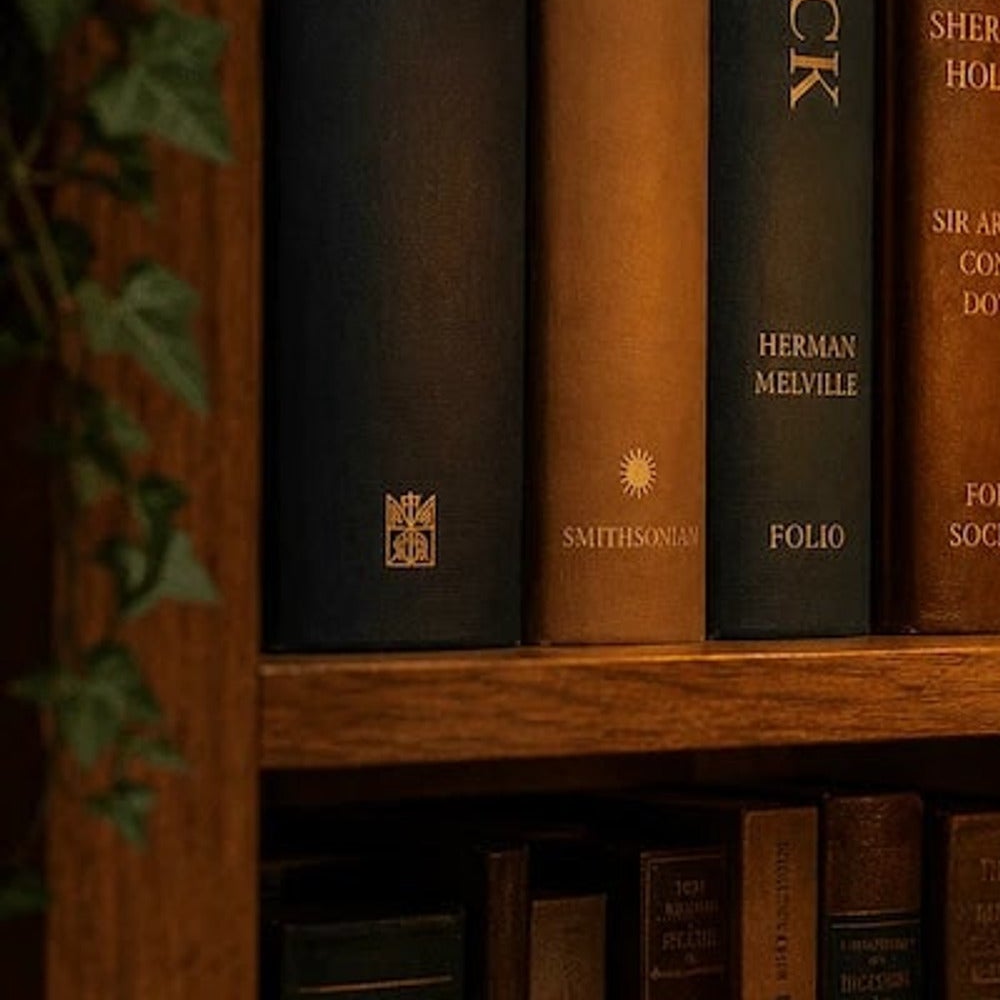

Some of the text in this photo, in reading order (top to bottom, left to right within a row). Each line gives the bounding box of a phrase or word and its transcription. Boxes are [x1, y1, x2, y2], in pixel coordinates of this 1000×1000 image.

[933, 208, 969, 235] SIR
[759, 332, 857, 359] HERMAN
[755, 371, 858, 397] MELVILLE
[562, 525, 699, 548] SMITHSONIAN
[769, 522, 846, 550] FOLIO
